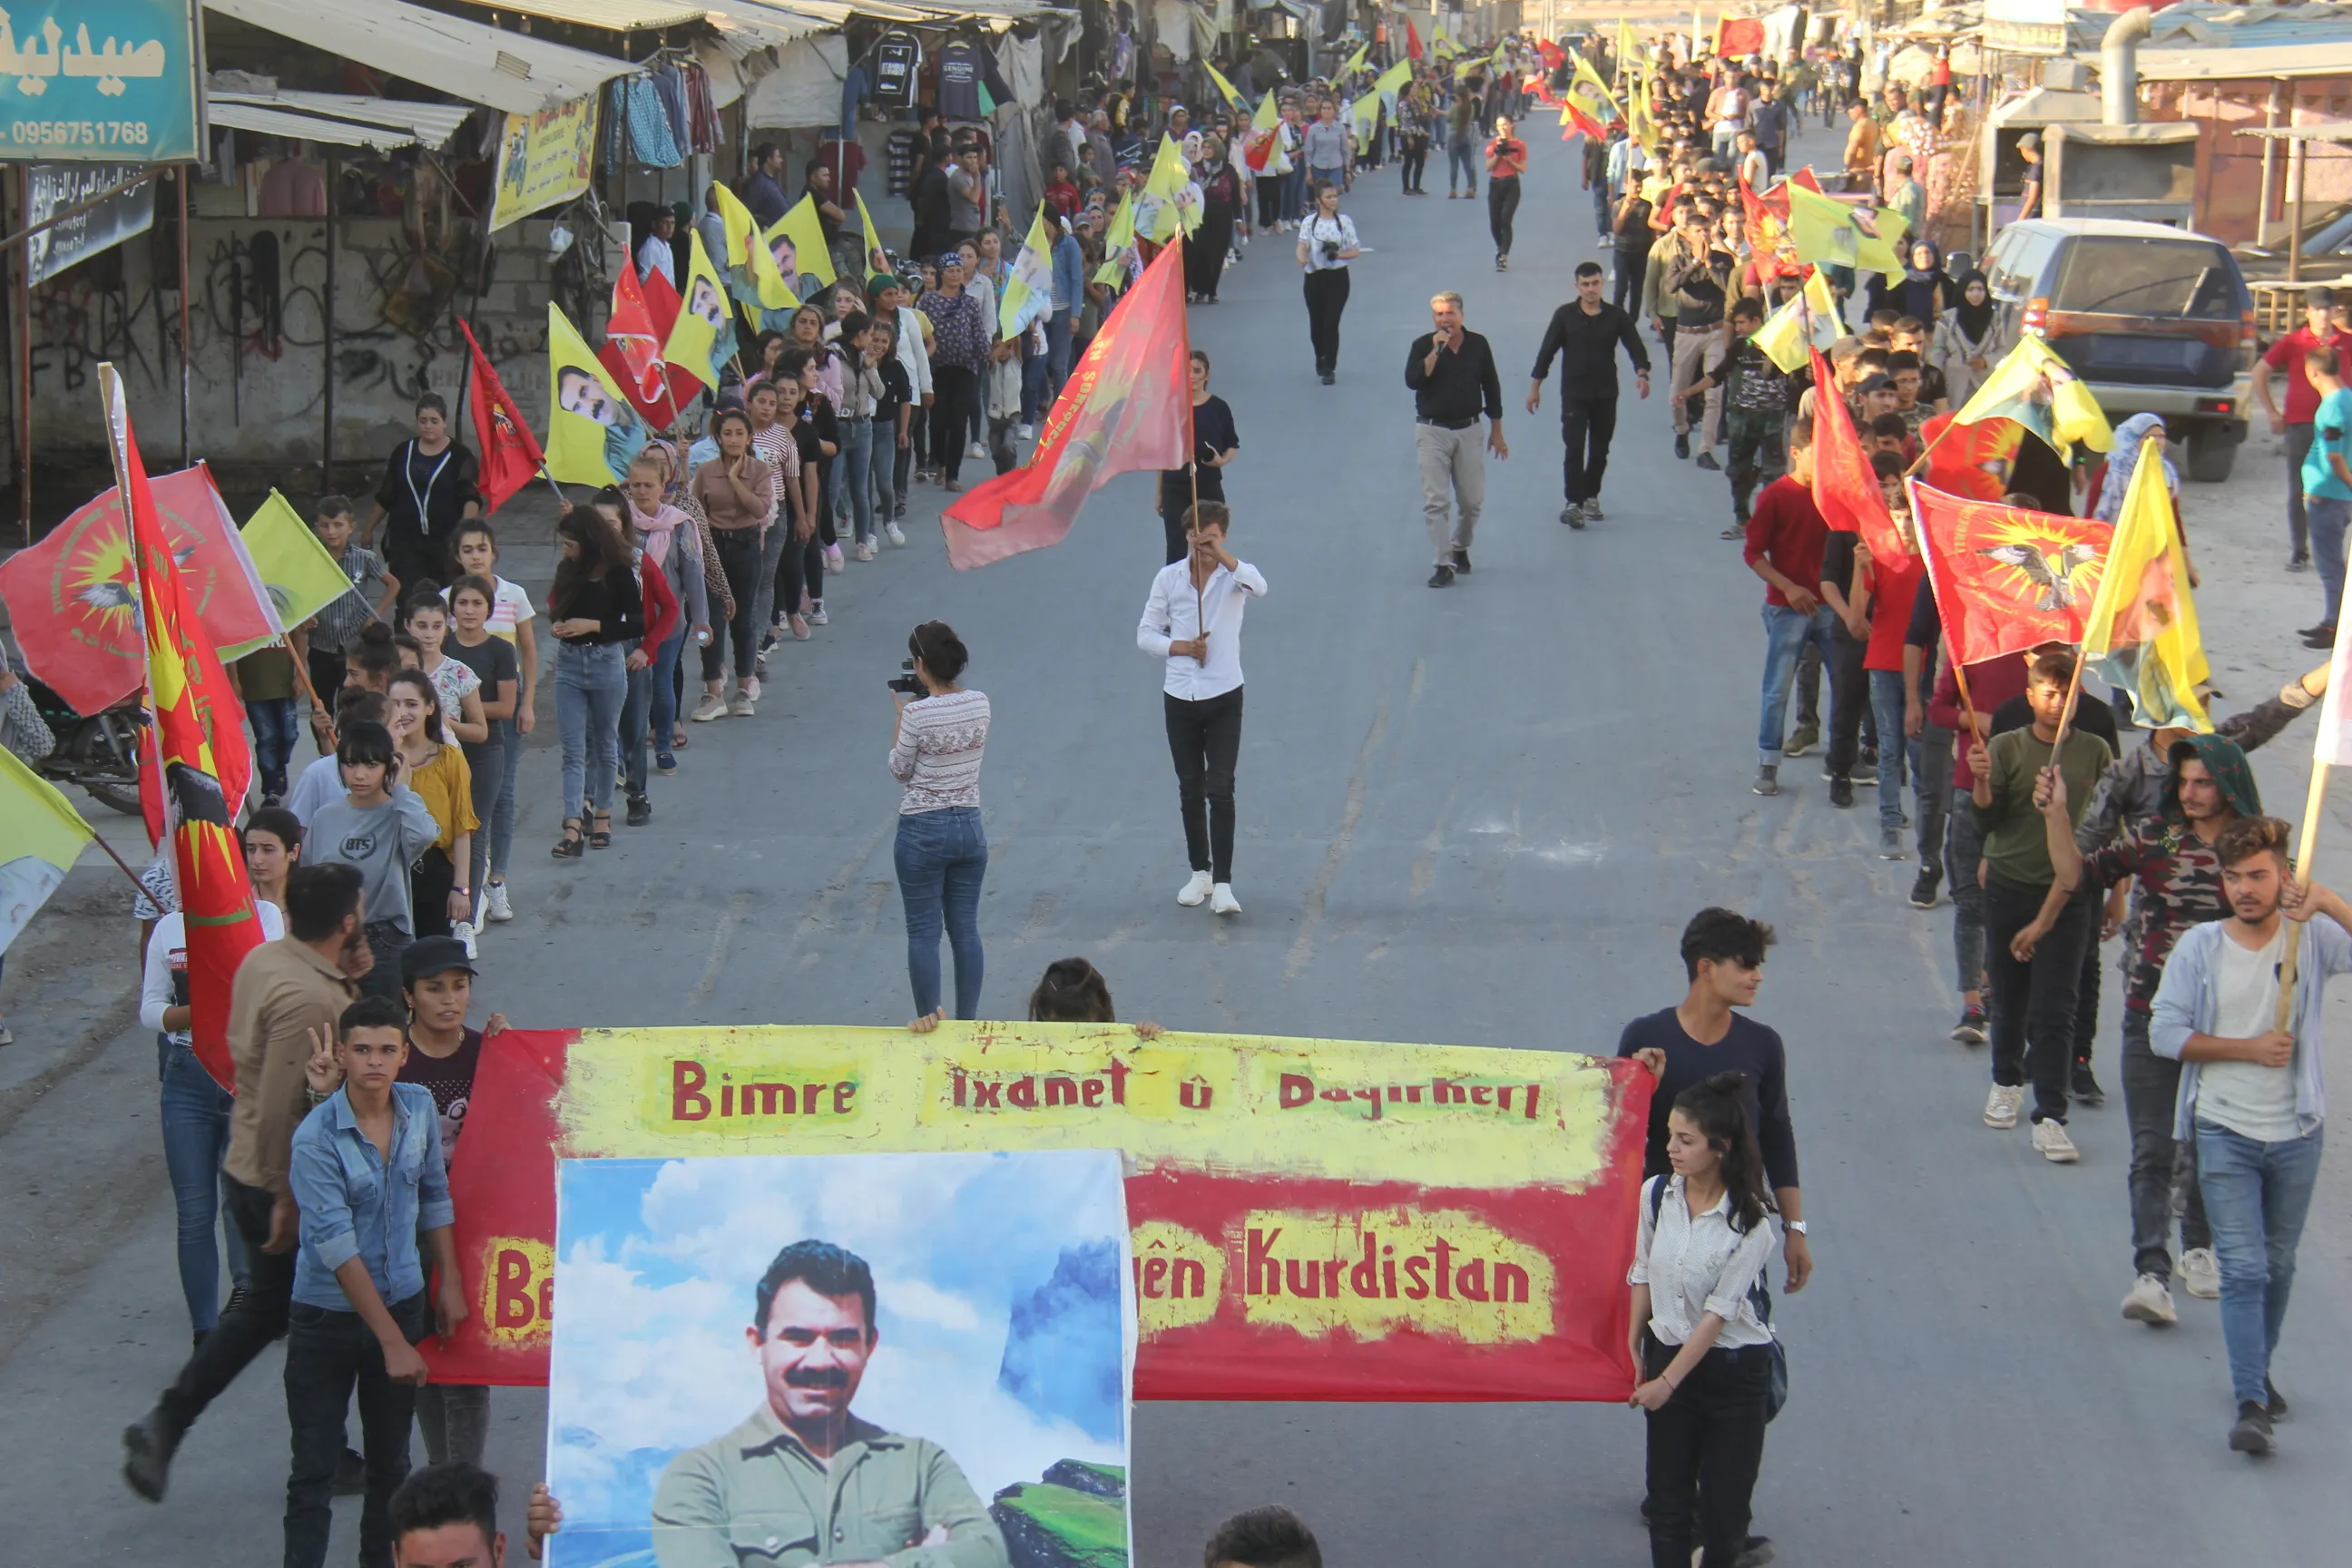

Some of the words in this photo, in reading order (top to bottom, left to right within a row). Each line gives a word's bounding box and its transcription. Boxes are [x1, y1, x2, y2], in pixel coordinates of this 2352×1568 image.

[13, 121, 149, 144] 0956751768
[346, 838, 370, 850] BTS
[672, 1061, 857, 1121] Bimre
[1246, 1227, 1531, 1303] Kurdistan
